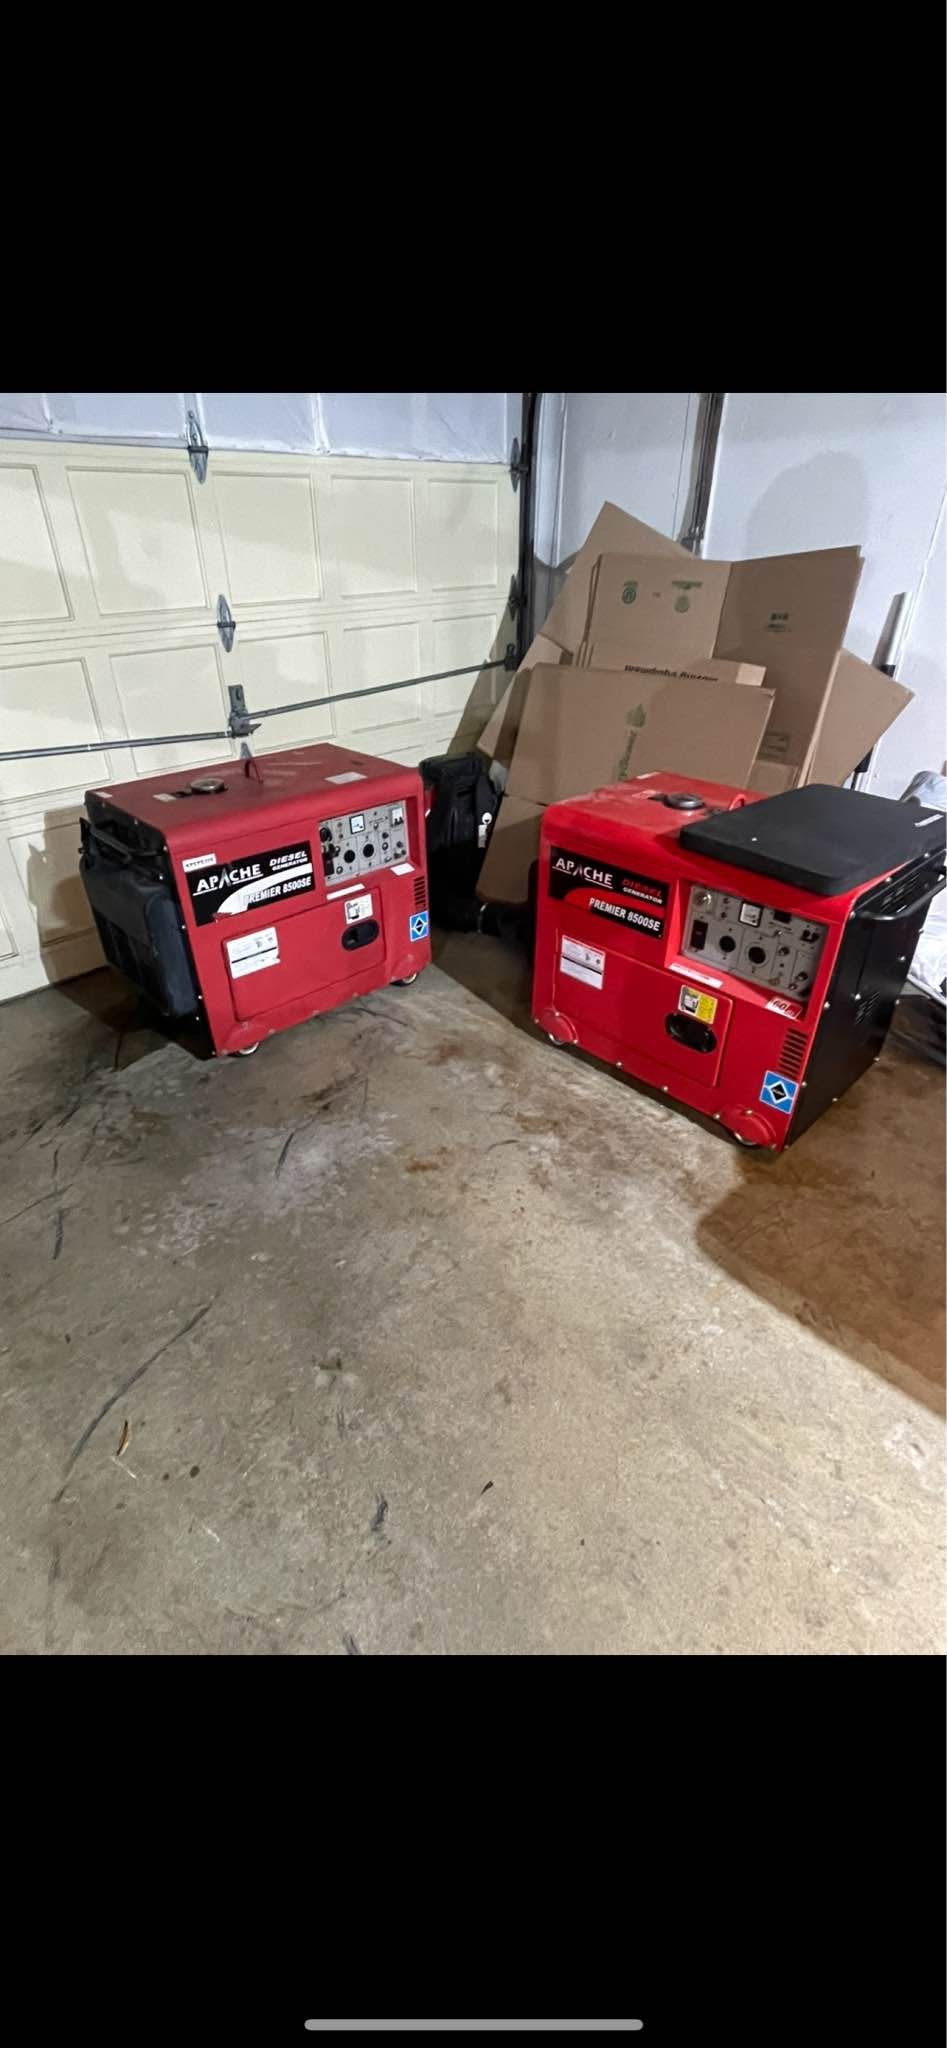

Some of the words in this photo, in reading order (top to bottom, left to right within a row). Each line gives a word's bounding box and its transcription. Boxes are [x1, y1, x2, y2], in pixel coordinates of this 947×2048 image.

[269, 851, 308, 867] DIESEL
[271, 857, 309, 872] GENERATOR
[555, 858, 613, 886] APACHE
[196, 863, 262, 893] APACHE
[242, 885, 282, 905] PREMIER
[282, 876, 312, 894] 8500SE
[622, 886, 663, 904] GENERATOR
[588, 897, 626, 919] PREMIER
[627, 911, 661, 932] 8500SE
